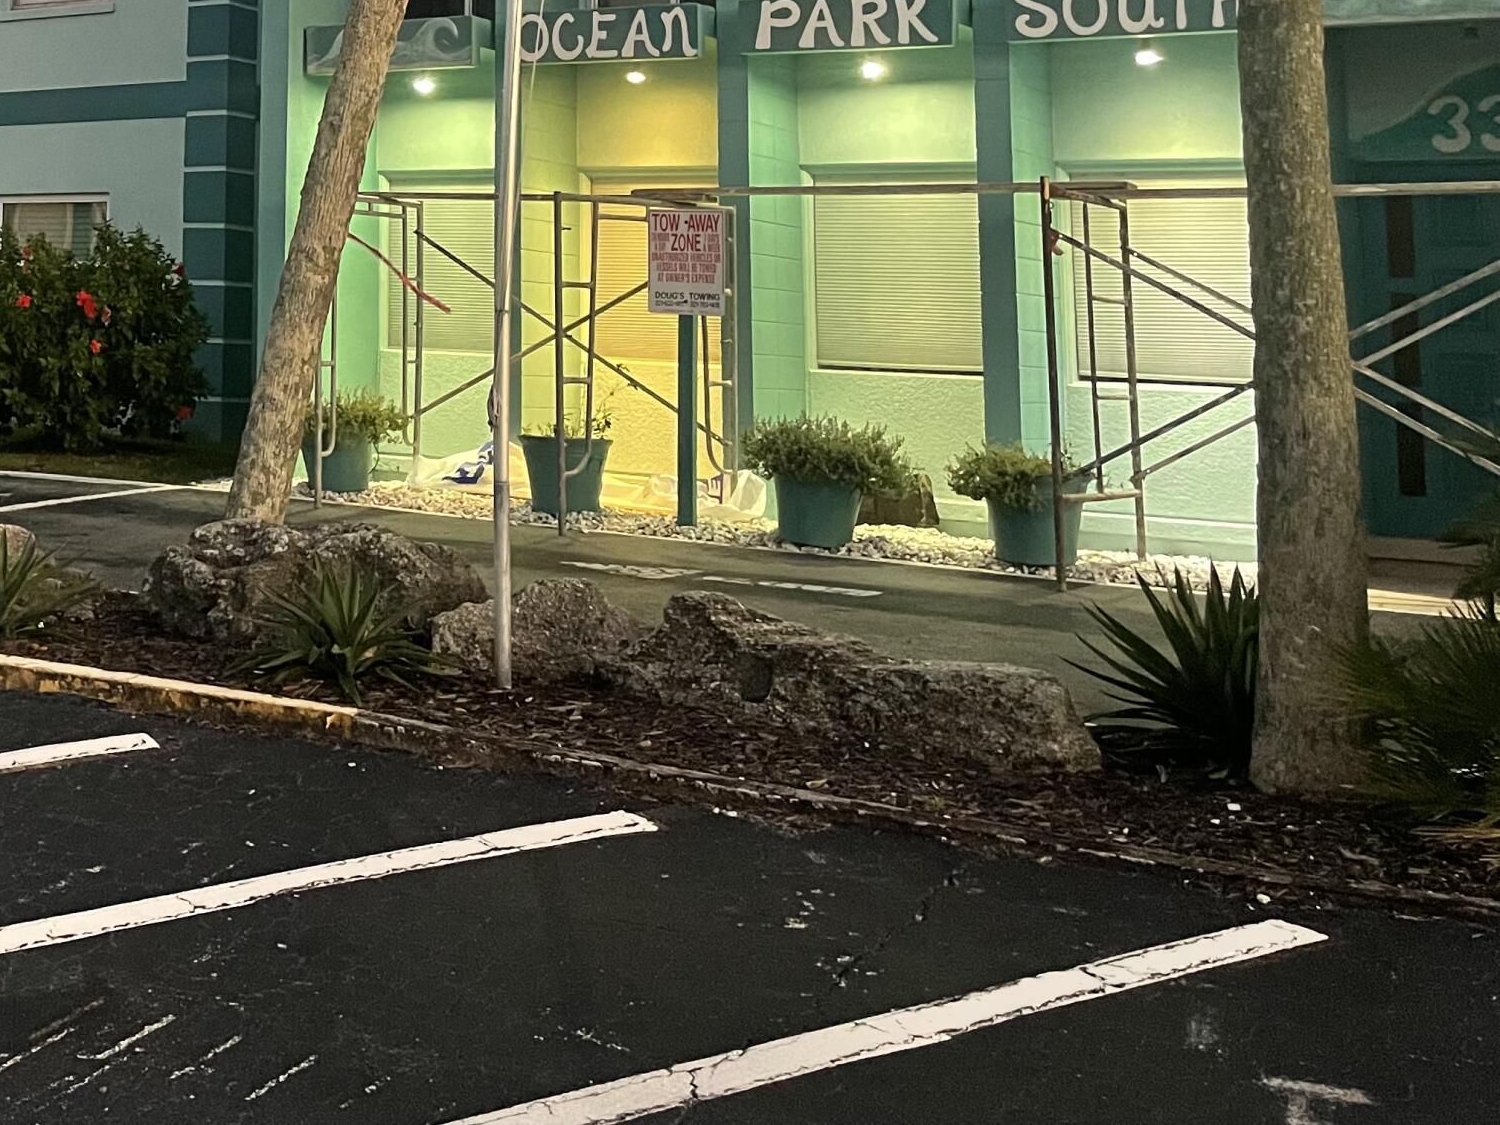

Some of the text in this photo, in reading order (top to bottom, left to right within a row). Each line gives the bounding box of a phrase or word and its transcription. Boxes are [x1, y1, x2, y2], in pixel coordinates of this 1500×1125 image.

[520, 6, 698, 62] OCEAN
[651, 213, 720, 232] TOW AWAY
[670, 233, 702, 252] ZONE
[689, 292, 720, 301] TOWING
